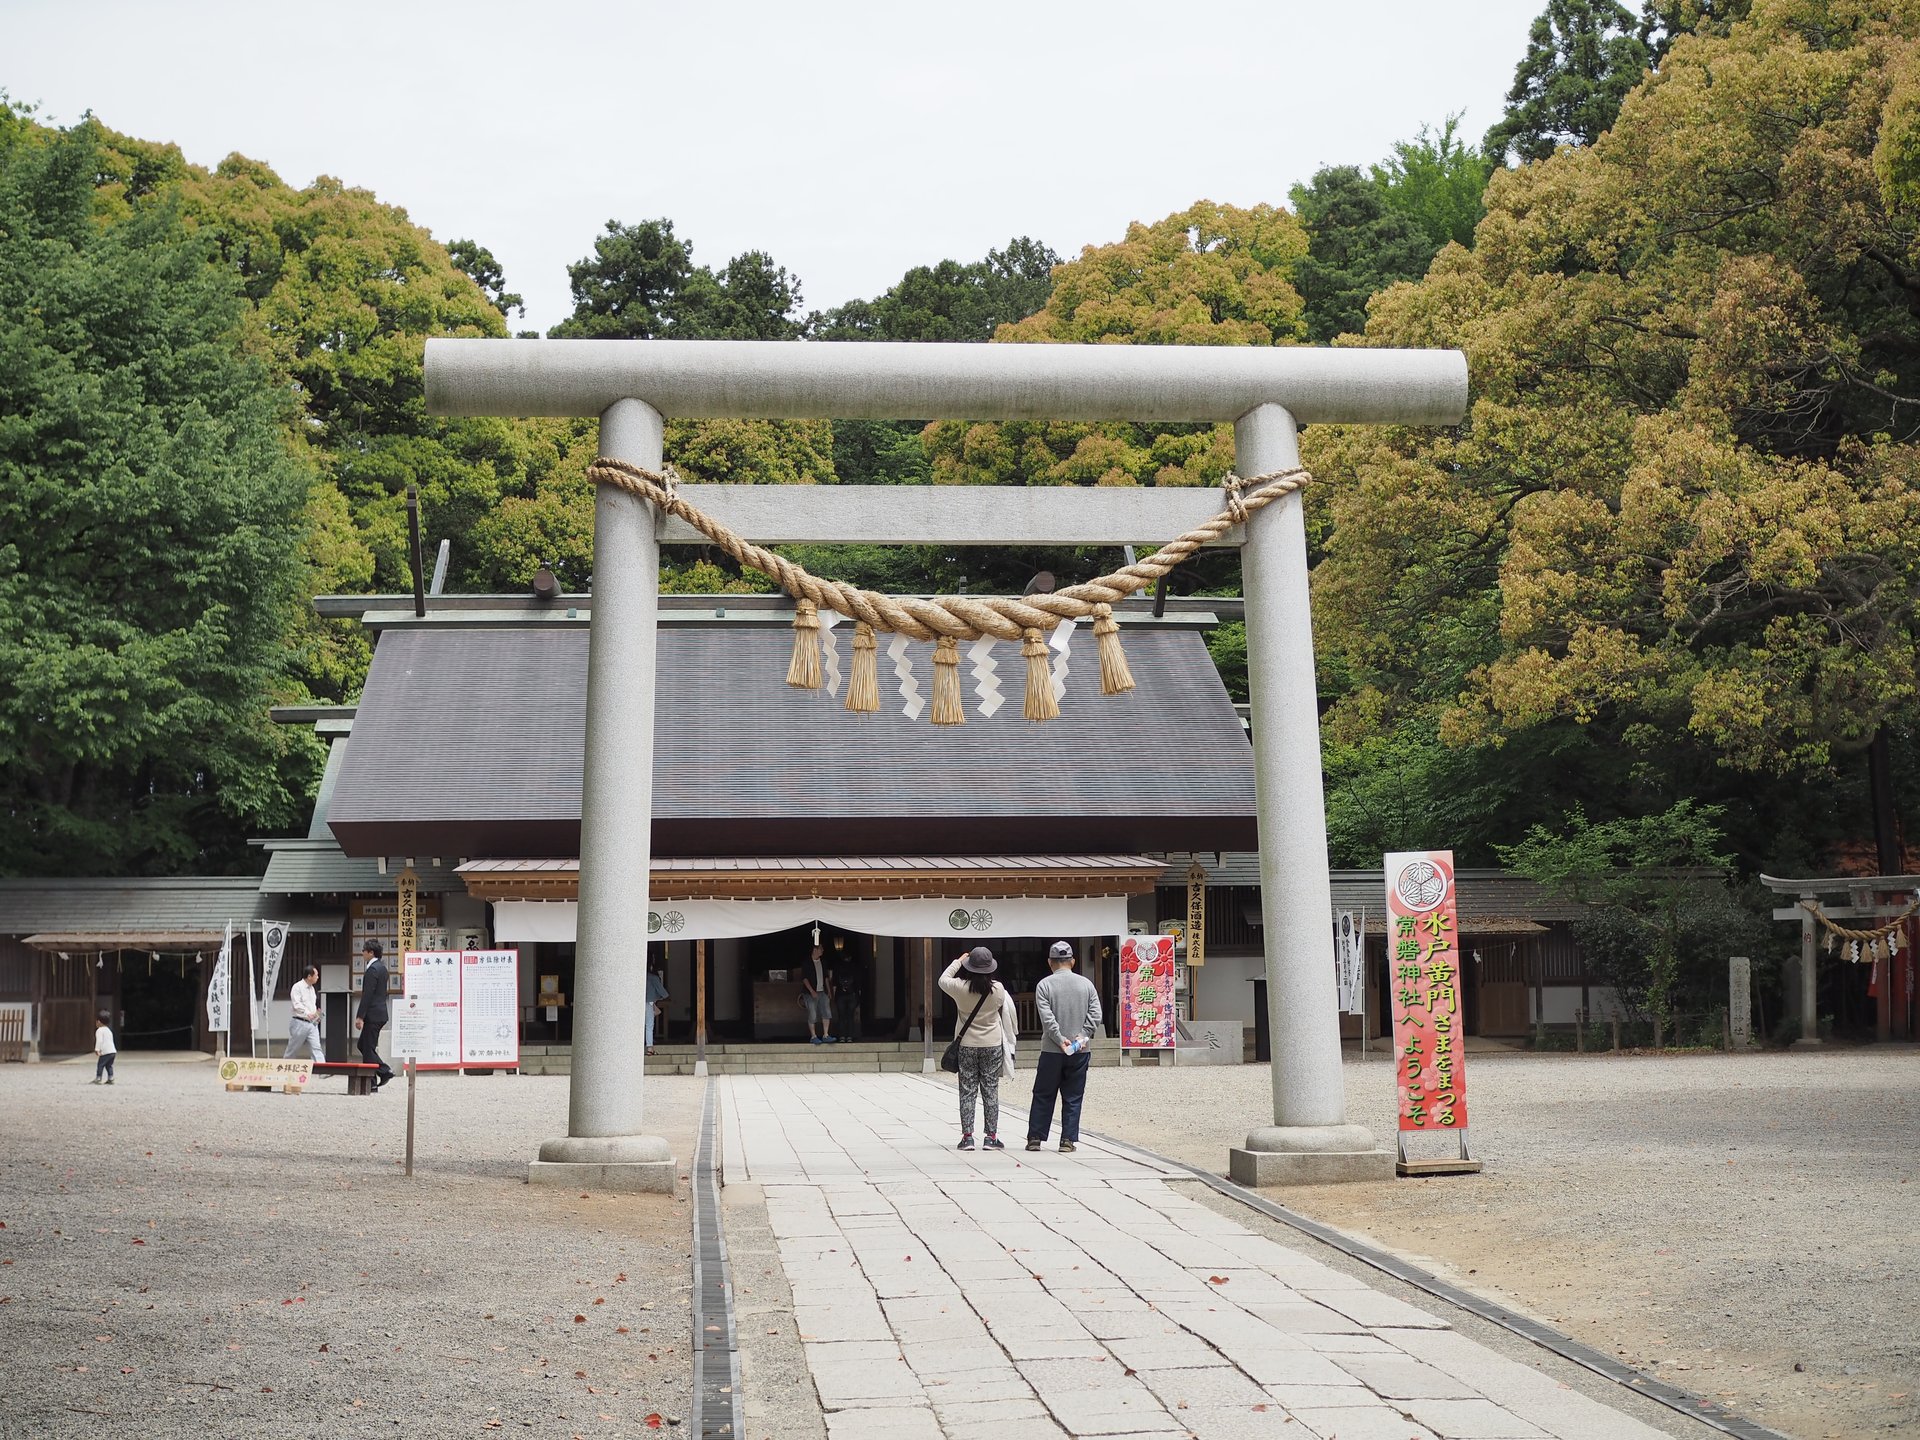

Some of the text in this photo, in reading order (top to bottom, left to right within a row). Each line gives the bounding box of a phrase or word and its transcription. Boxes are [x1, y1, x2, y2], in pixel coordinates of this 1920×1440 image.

[276, 1063, 309, 1073] 参拝記念
[1138, 965, 1158, 1044] 常磐神社
[1394, 914, 1428, 1127] 常磐神社へようこそ
[1422, 910, 1457, 1127] 水戸黄門さまをまつる
